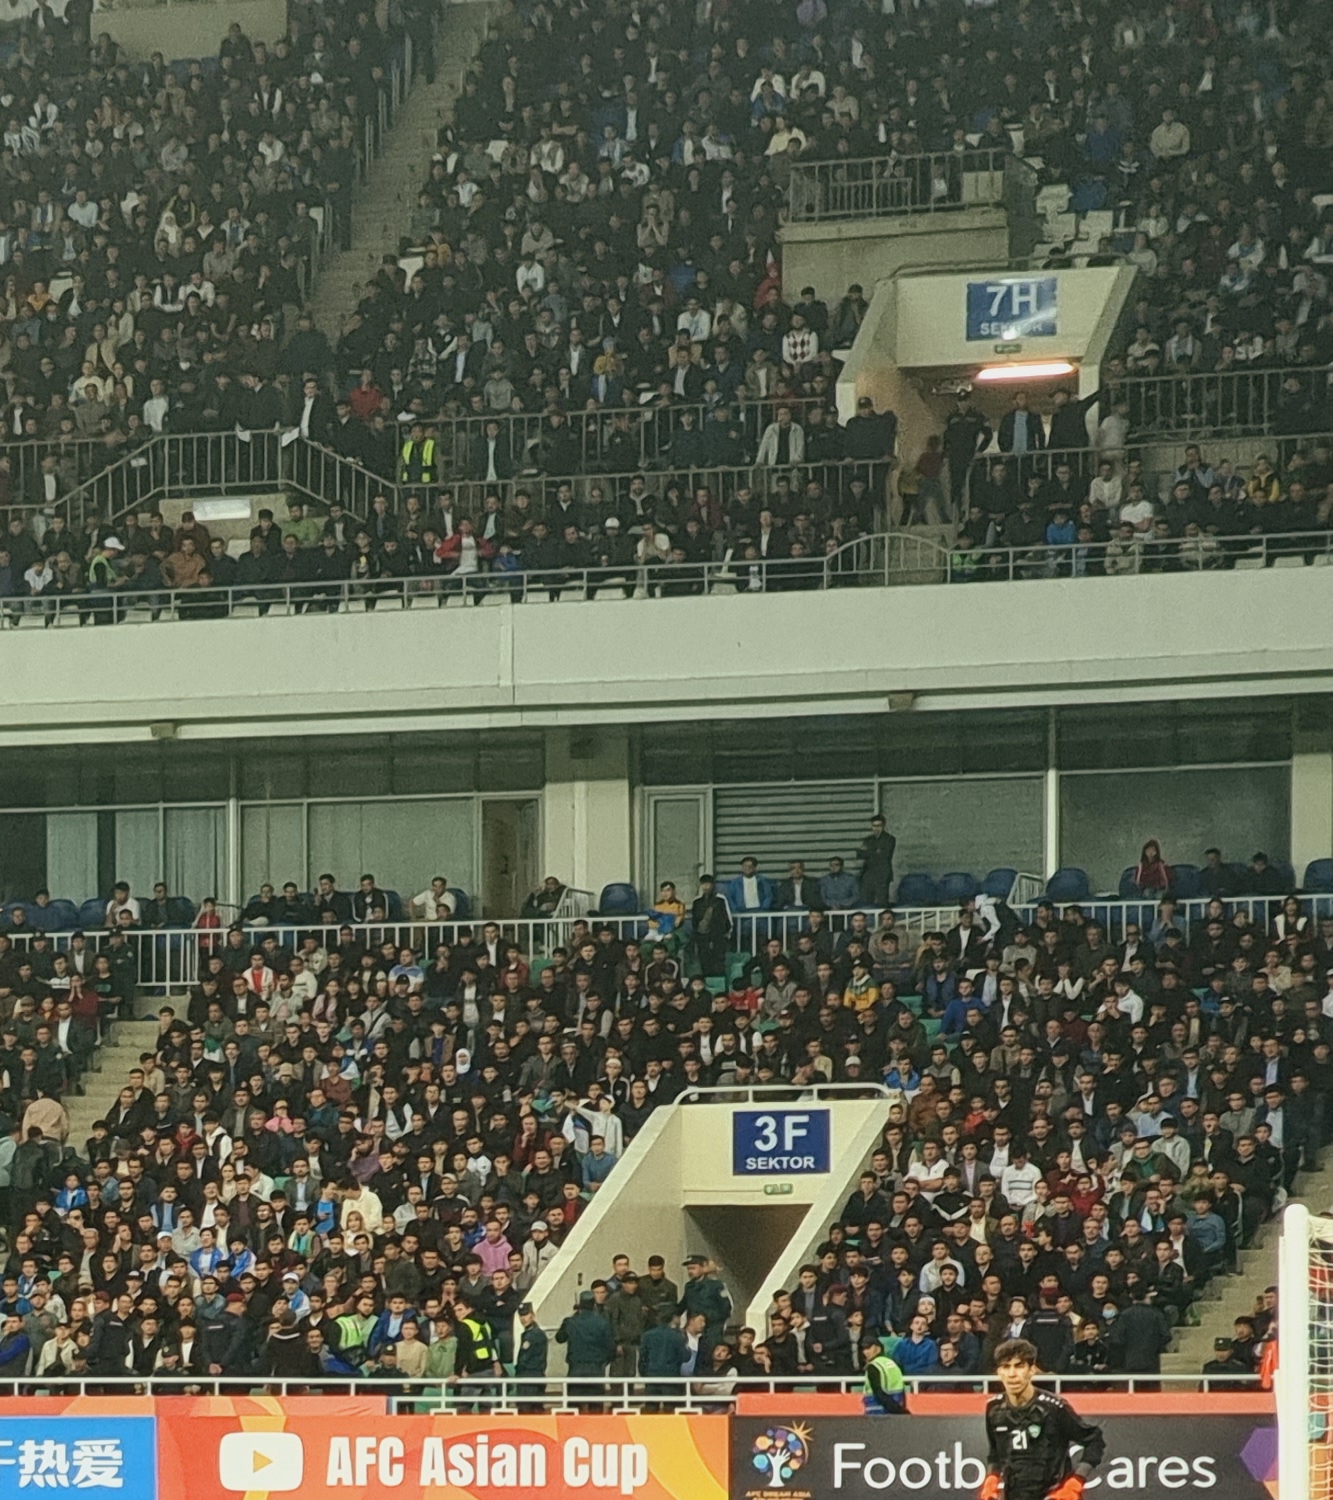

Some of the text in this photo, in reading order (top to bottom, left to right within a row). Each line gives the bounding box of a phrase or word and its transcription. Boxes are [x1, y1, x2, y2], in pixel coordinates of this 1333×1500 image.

[986, 284, 1038, 316] 7H
[754, 1114, 810, 1151] 3F
[745, 1156, 815, 1170] SEKTOR
[1011, 1429, 1028, 1450] 21
[326, 1434, 649, 1495] AFC Asian Cup
